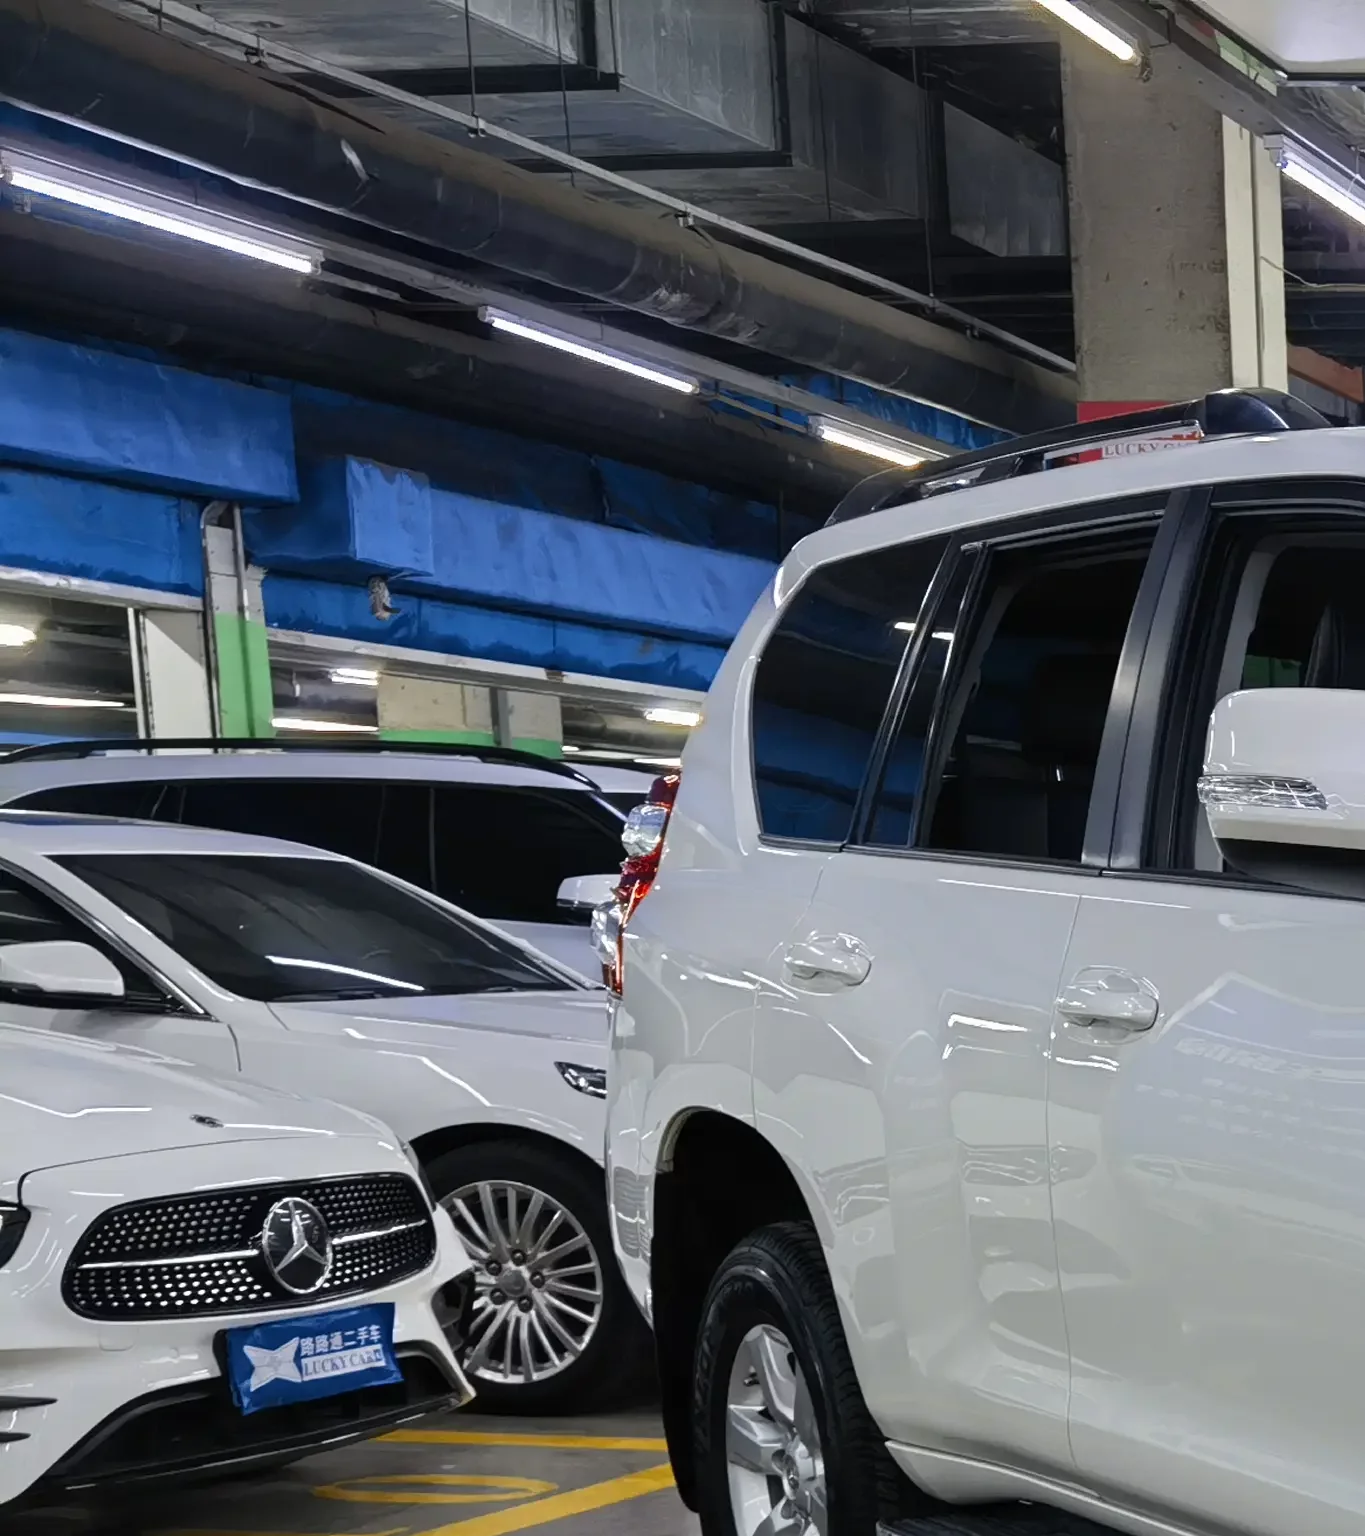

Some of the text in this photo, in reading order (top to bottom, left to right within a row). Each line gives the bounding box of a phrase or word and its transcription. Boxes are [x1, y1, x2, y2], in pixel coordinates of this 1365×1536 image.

[1104, 443, 1160, 456] LUCKY
[300, 1324, 382, 1357] 路路通二手车
[303, 1348, 378, 1377] LUCKY CAR
